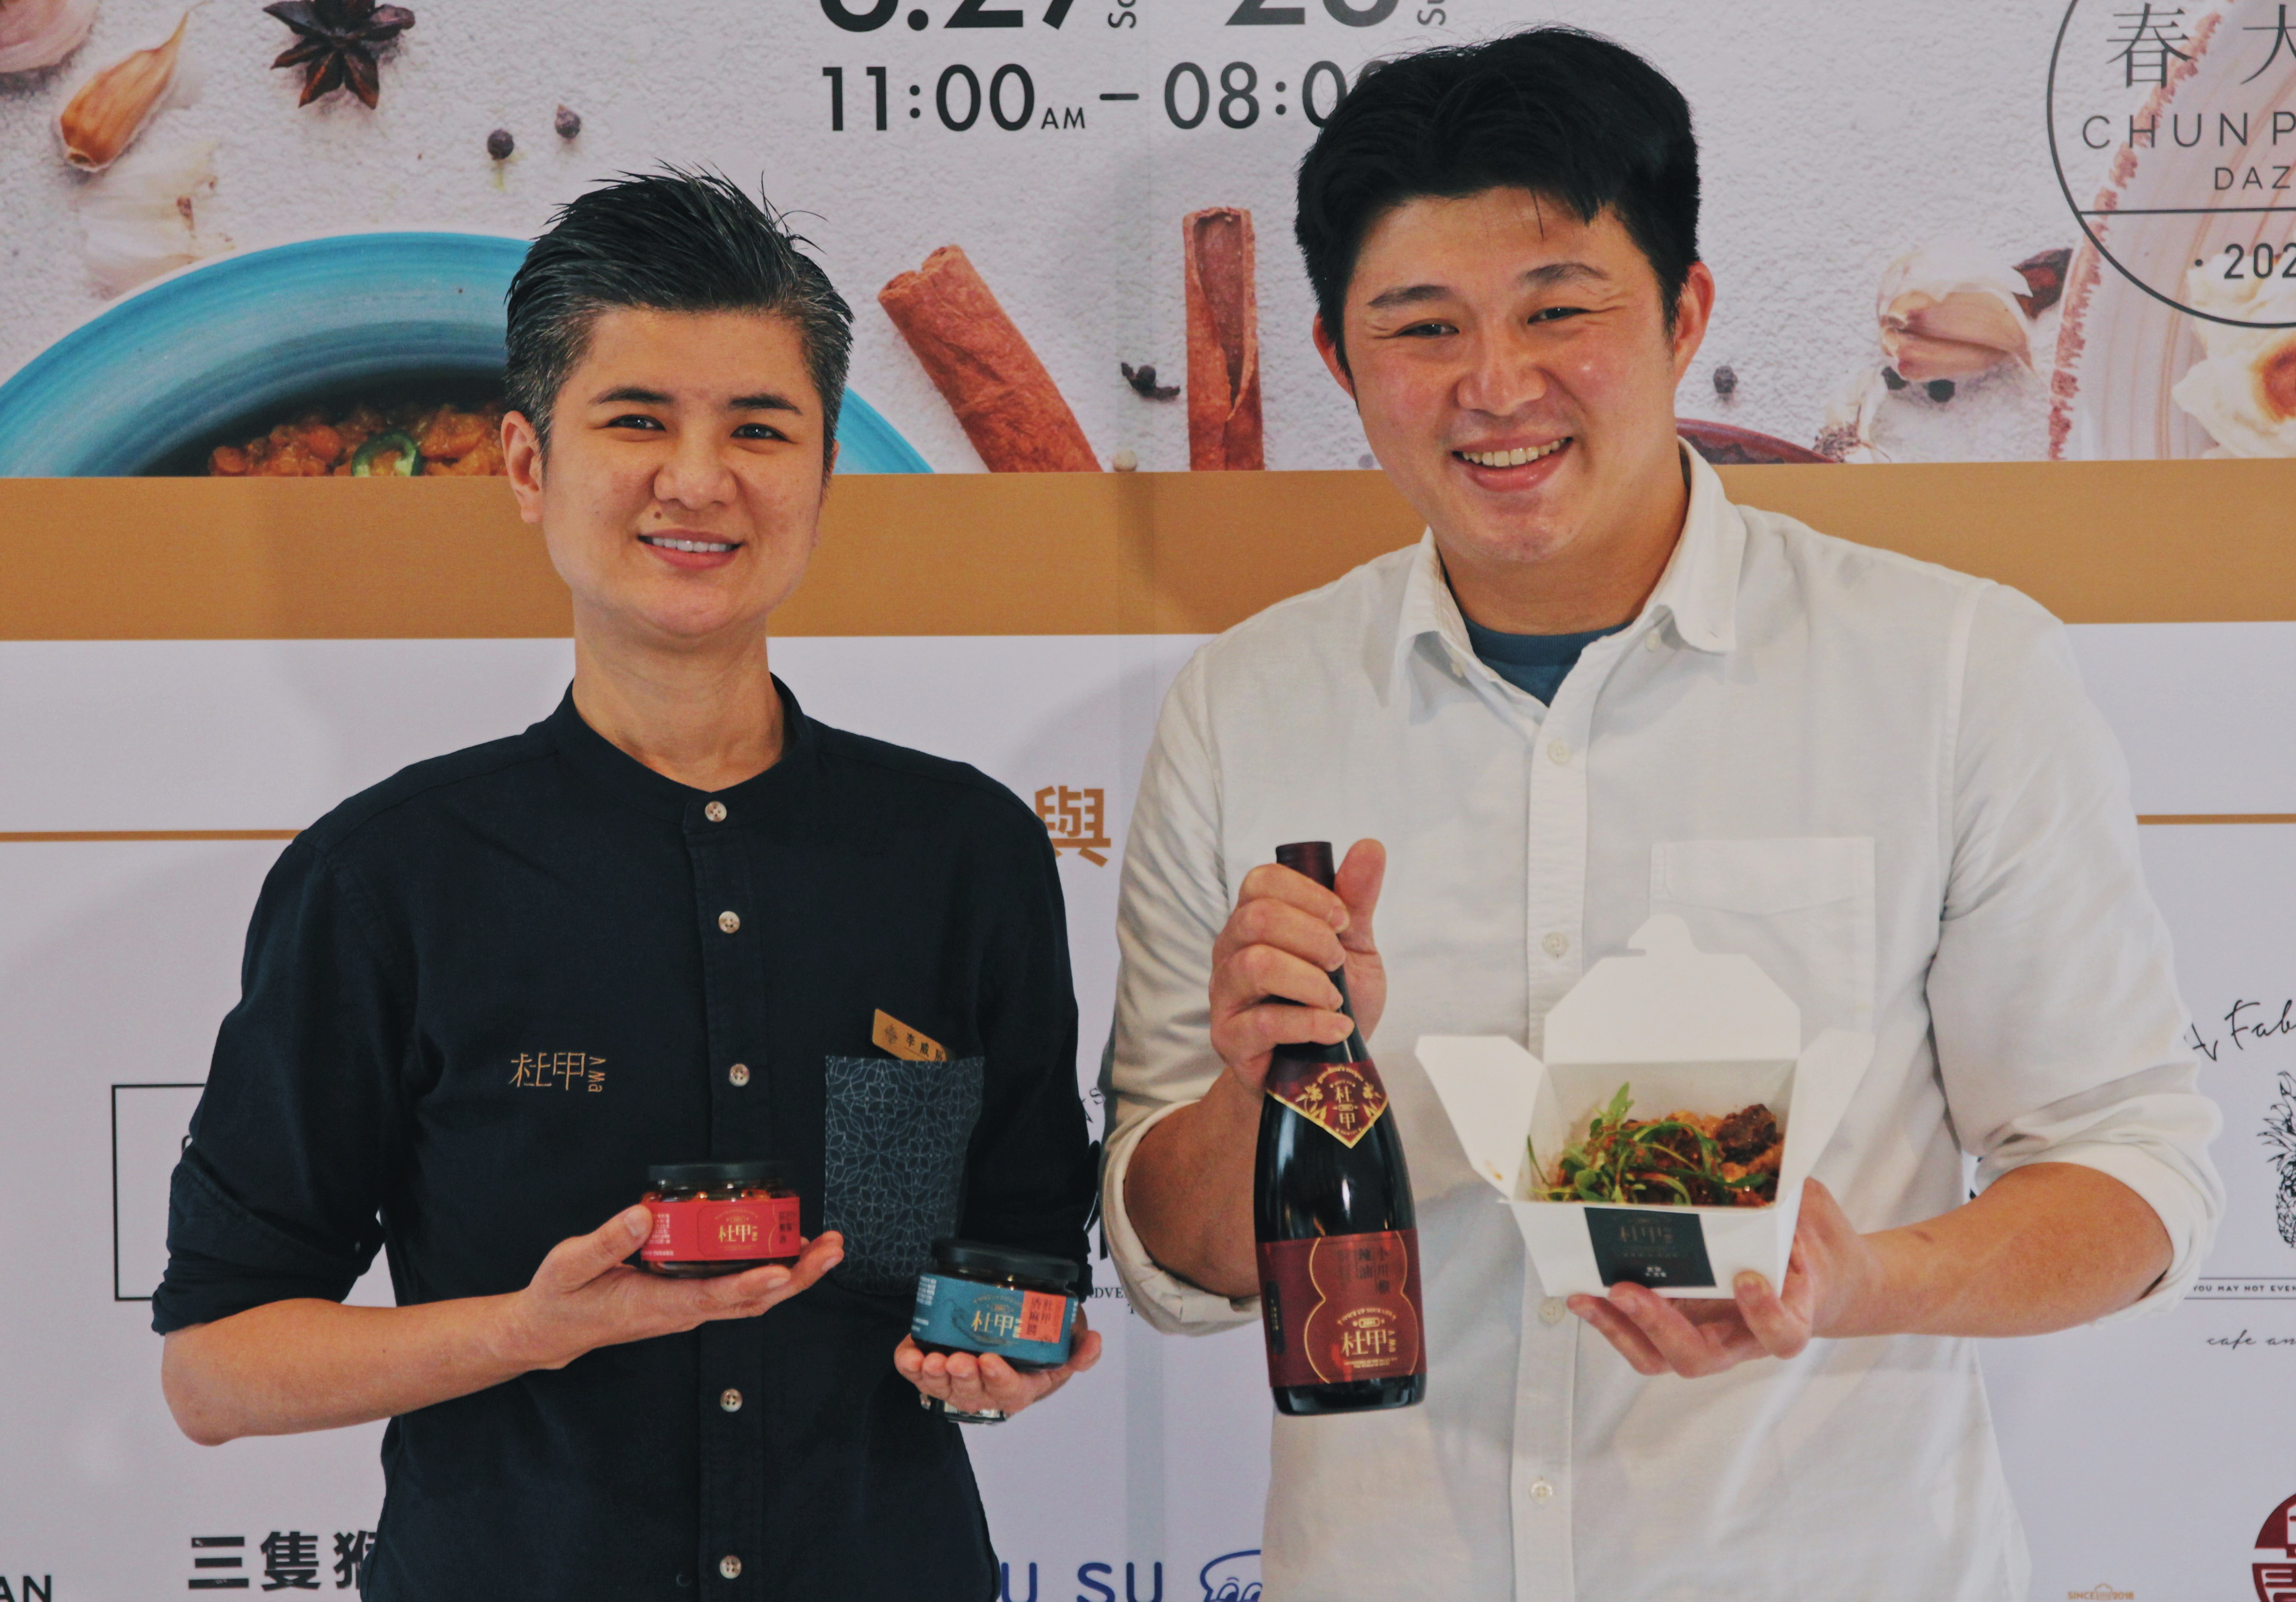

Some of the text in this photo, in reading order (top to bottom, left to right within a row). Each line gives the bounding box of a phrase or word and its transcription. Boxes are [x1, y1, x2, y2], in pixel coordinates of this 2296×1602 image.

[1165, 60, 1391, 129] 08:0
[2215, 166, 2291, 190] DAZ
[1035, 785, 1111, 867] 與
[1088, 1287, 1127, 1299] DVE
